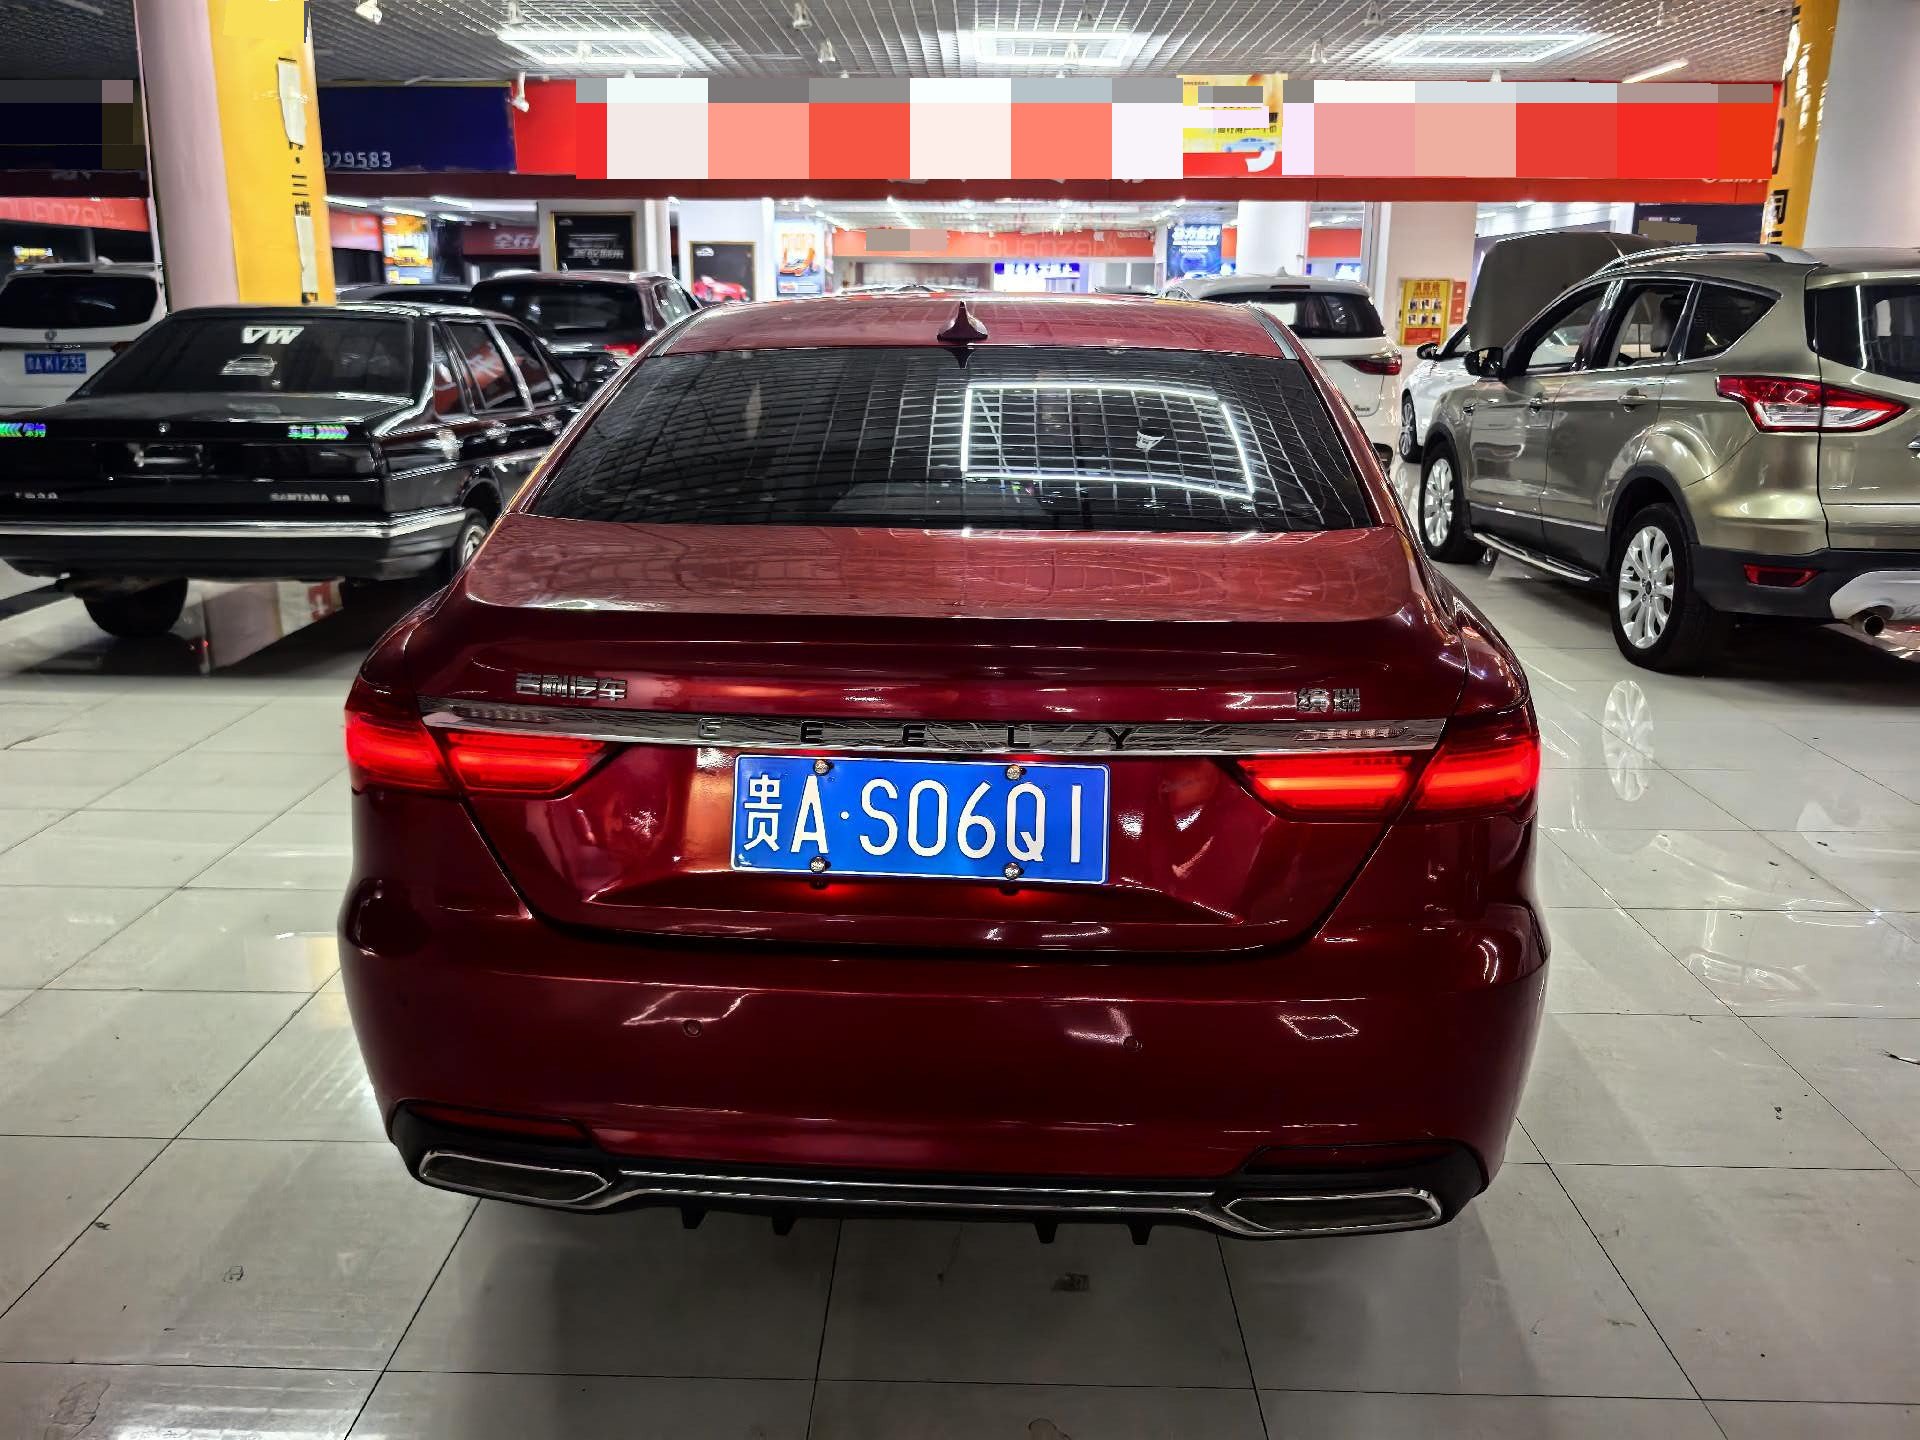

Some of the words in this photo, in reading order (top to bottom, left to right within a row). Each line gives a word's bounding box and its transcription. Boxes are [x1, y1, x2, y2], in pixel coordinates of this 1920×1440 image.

[242, 325, 305, 345] VW
[516, 672, 627, 701] 吉利汽车
[701, 716, 1134, 750] GEELY
